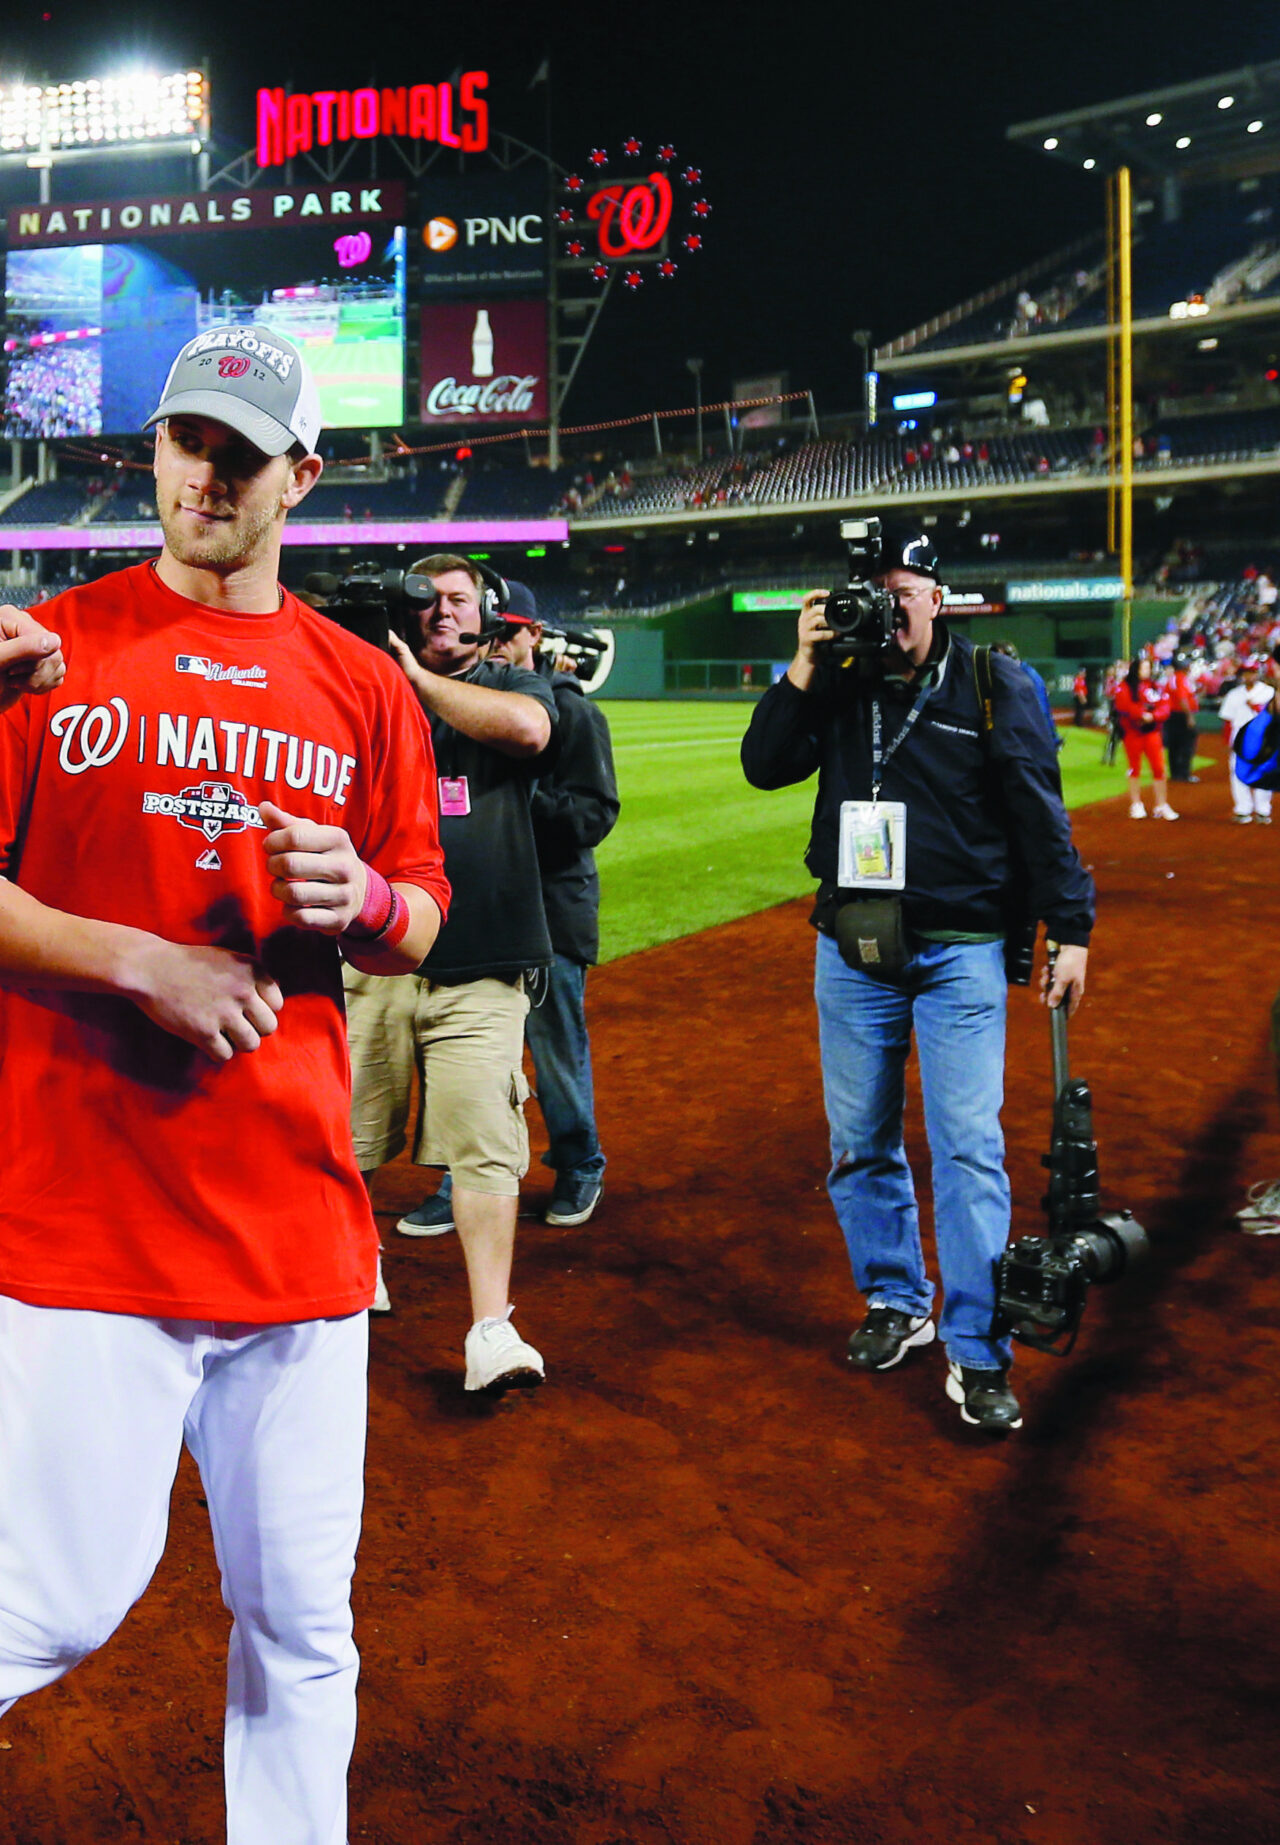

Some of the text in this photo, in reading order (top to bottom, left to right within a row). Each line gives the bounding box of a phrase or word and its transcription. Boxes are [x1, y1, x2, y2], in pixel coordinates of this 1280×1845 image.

[256, 71, 488, 168] NATIONALS
[19, 188, 382, 236] NATIONALS PARK
[464, 214, 543, 247] PNC
[586, 171, 673, 257] W
[186, 332, 295, 383] PLAYOFFS
[198, 356, 266, 381] 20 W 12
[205, 663, 267, 681] Authentic
[50, 696, 357, 806] W NATITUDE
